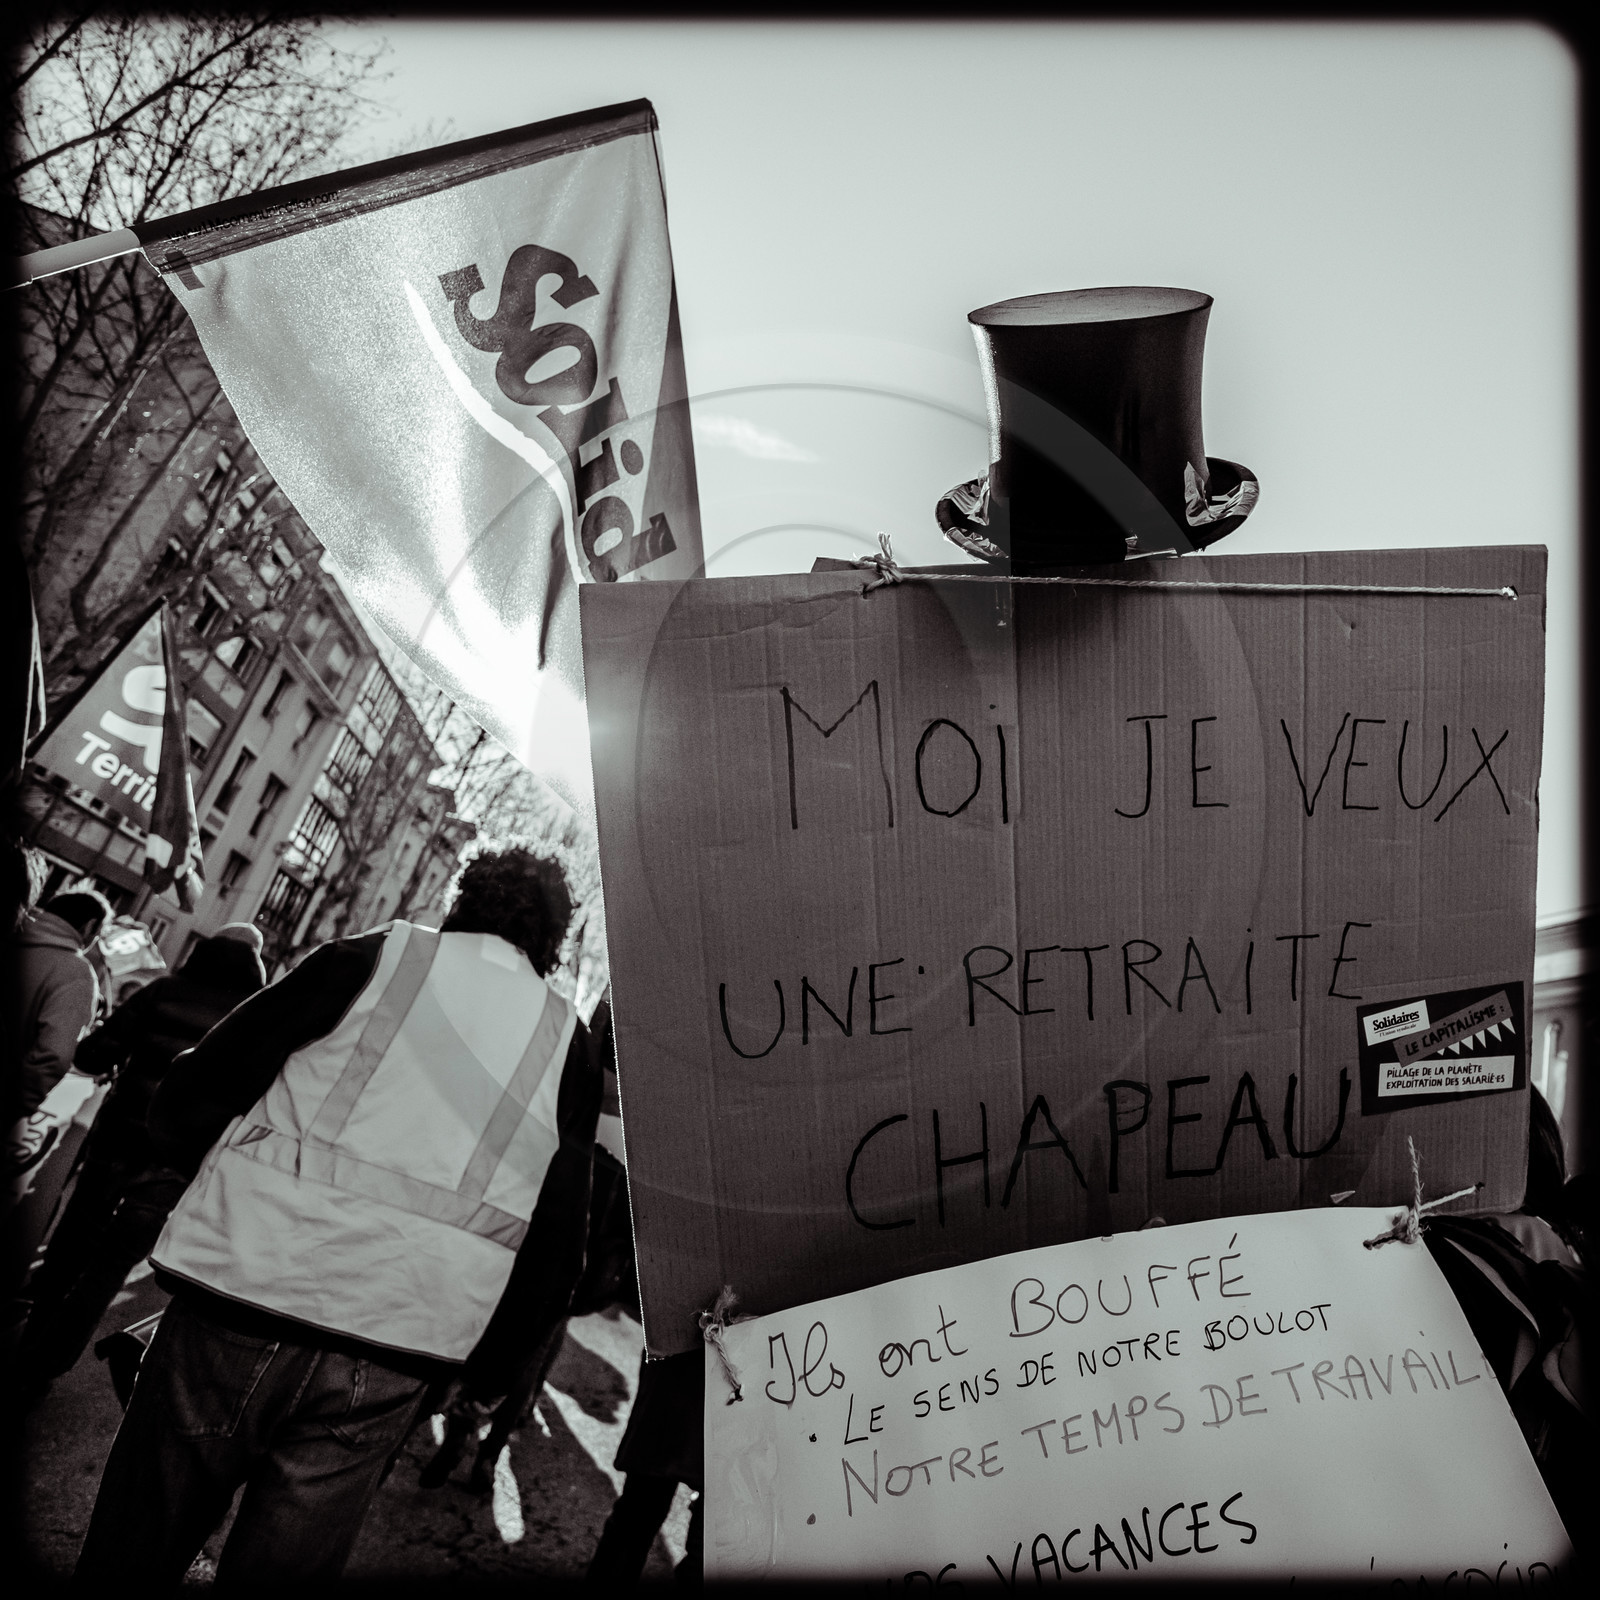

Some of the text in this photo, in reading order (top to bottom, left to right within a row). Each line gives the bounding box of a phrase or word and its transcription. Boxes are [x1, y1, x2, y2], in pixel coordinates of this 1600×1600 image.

[1114, 714, 1230, 819] JE
[1281, 713, 1511, 823] VEUX
[1373, 1010, 1420, 1031] Solidaires
[1405, 1041, 1418, 1056] LE
[1422, 1067, 1432, 1076] DE
[1434, 1066, 1445, 1076] LA
[1447, 1063, 1483, 1075] PLANÈTE
[1445, 1077, 1460, 1087] DES
[845, 1069, 1352, 1231] CHAPEAU
[878, 1305, 969, 1379] ont
[1009, 1233, 1253, 1340] BOUFFÉ
[914, 1367, 1001, 1419] SENS
[1019, 1351, 1056, 1389] DE
[1078, 1329, 1182, 1379] NOTRE
[1203, 1304, 1333, 1352] BOULOT
[842, 1440, 1003, 1518] NOTRE
[1021, 1394, 1186, 1460] TEMPS
[1201, 1375, 1268, 1429] DE
[986, 1492, 1258, 1598] VACANCES
